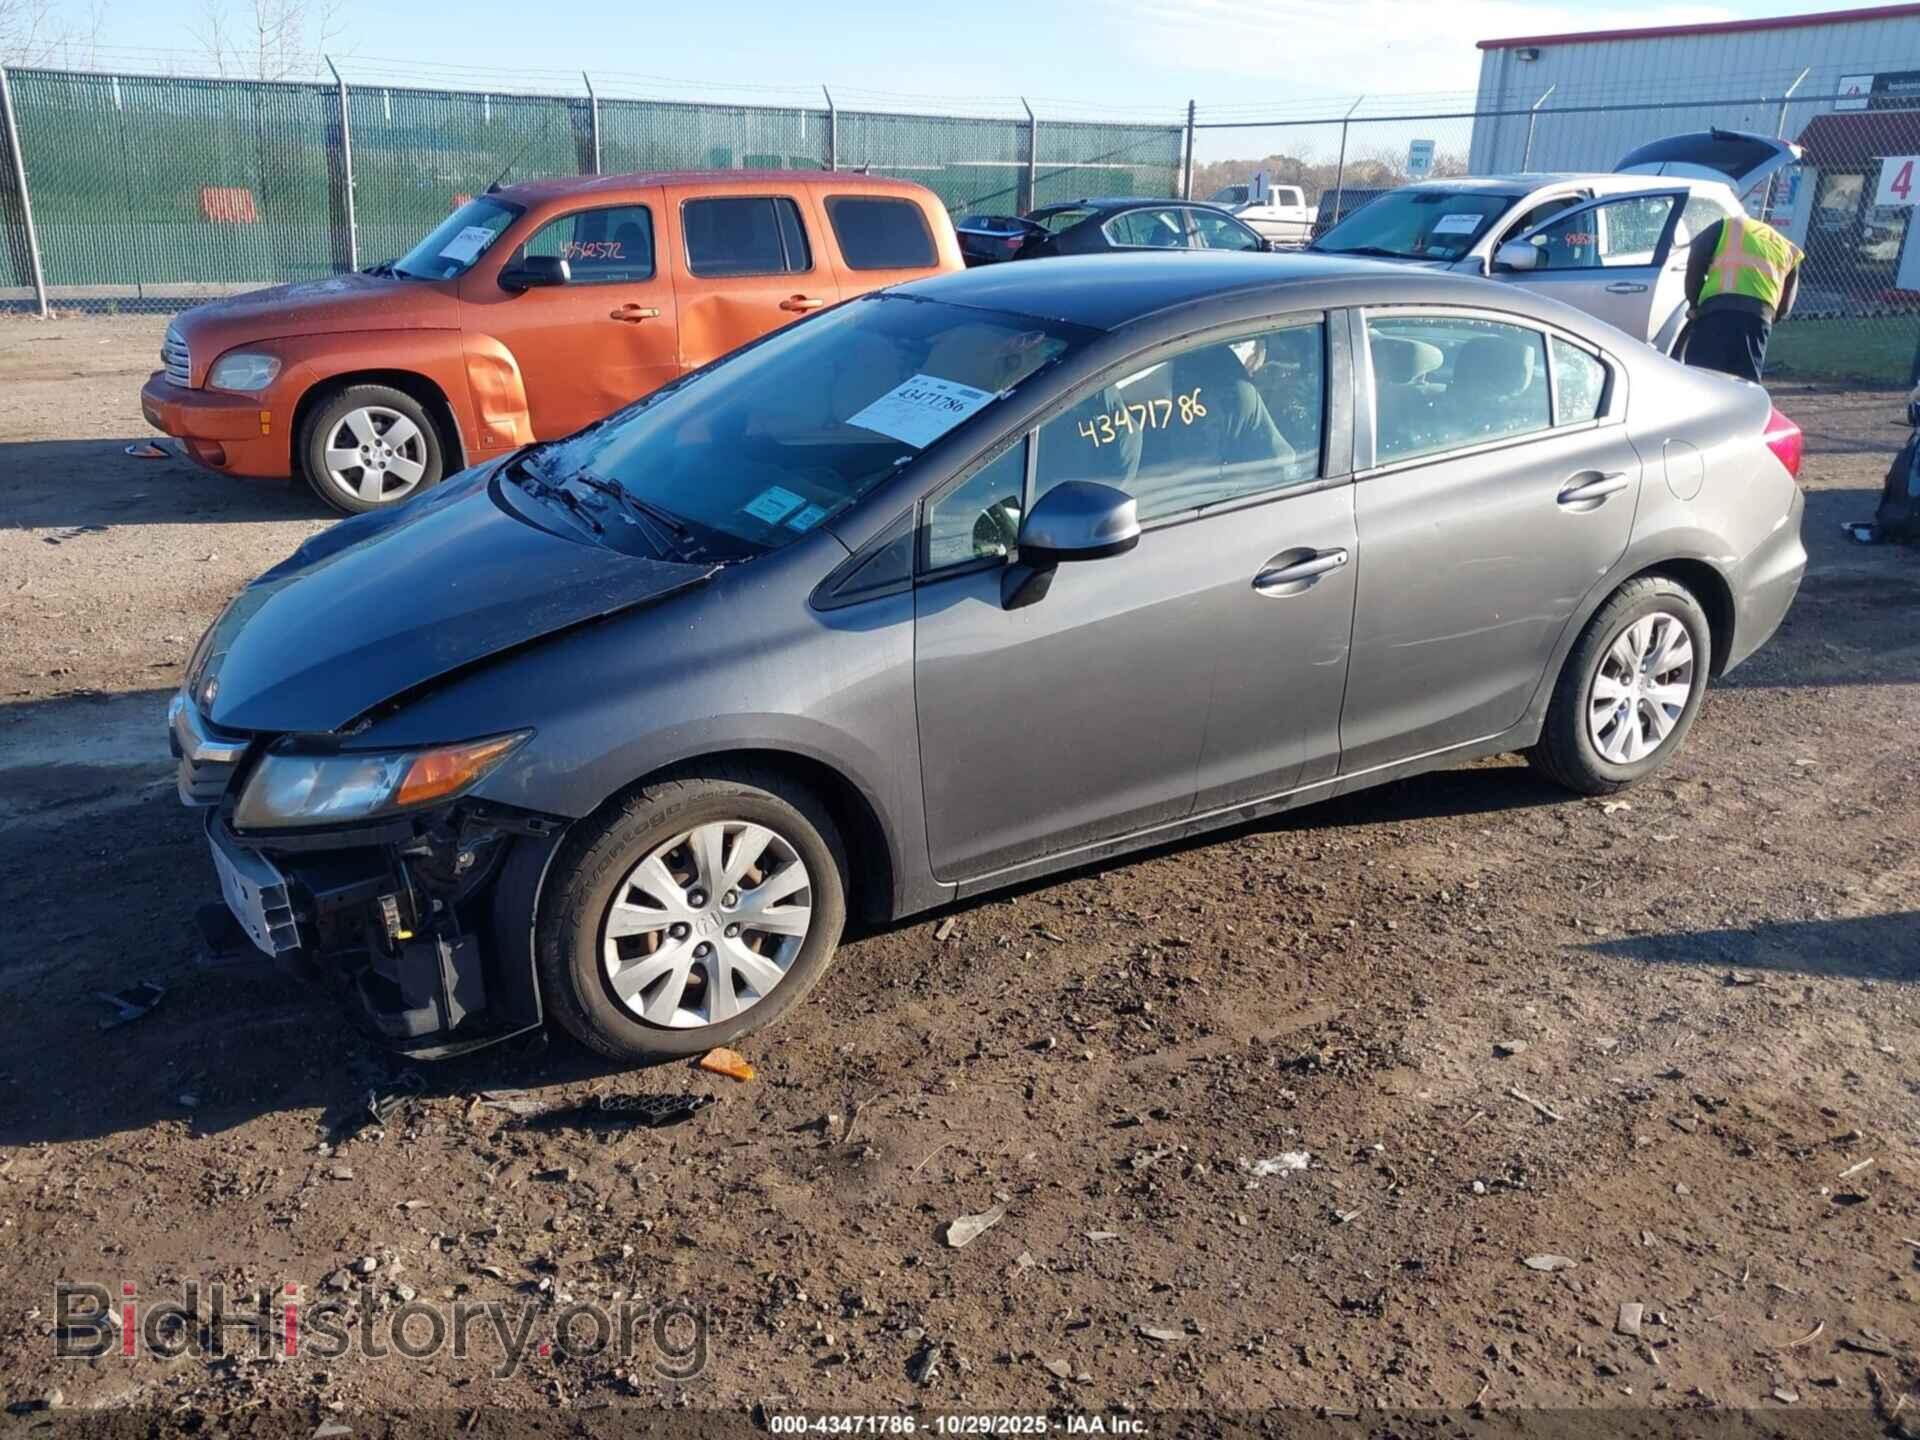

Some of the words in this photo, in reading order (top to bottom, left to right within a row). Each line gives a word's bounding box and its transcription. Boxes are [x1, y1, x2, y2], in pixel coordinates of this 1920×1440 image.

[1254, 172, 1262, 198] 1
[1890, 161, 1914, 200] 4
[899, 387, 965, 413] 43471786
[1078, 388, 1207, 448] 43471786
